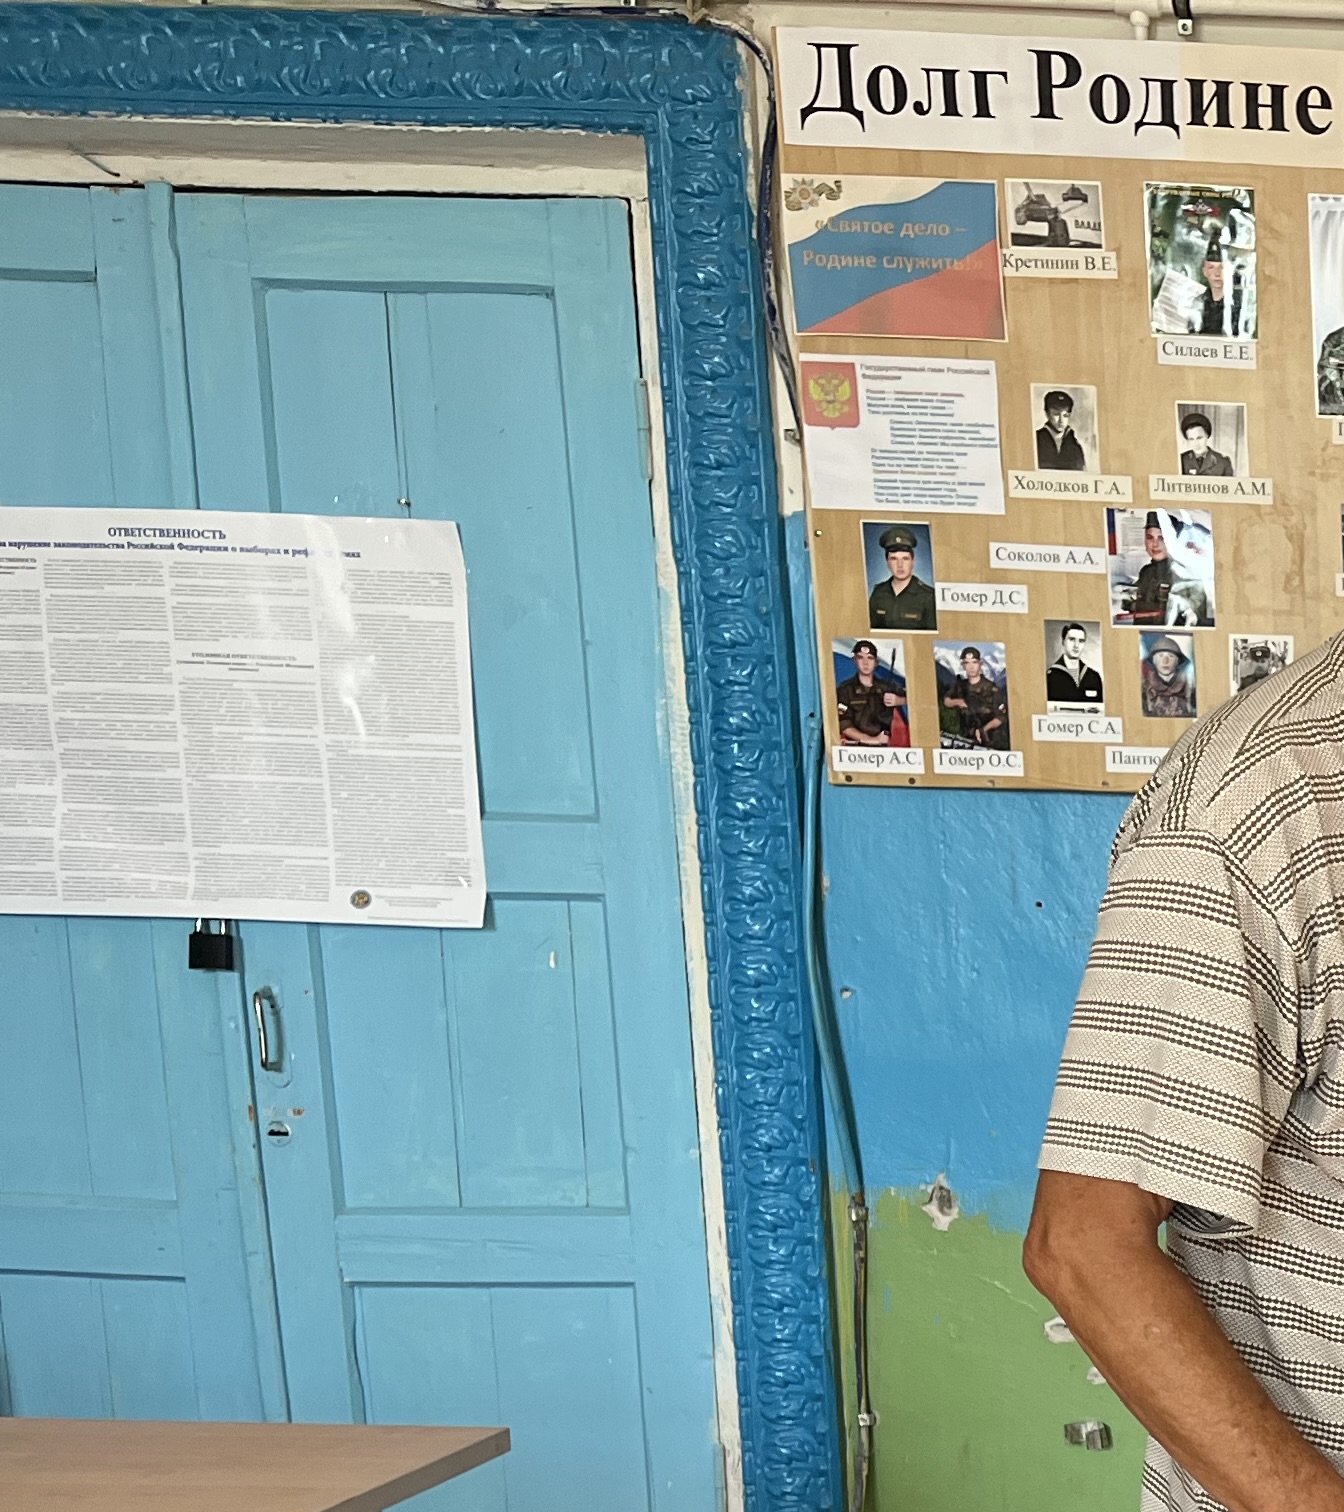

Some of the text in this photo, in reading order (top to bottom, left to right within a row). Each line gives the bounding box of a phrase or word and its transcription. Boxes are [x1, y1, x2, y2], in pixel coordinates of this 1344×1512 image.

[800, 42, 1008, 132] Долг
[1027, 48, 1333, 140] Родине
[815, 216, 895, 235] «Святое
[899, 222, 950, 238] дело
[803, 249, 877, 270] Родине
[1002, 253, 1117, 272] Кретинин В.Е.
[1162, 341, 1254, 361] Силаев Е.Е.
[1013, 473, 1126, 496] Холодков Г.А.
[1154, 478, 1271, 498] Литвинов А.М.
[107, 526, 227, 540] ОТВЕТСТВЕННОСТЬ
[996, 547, 1099, 566] Соколов А.А.
[941, 588, 1025, 608] Гомер Д.С.
[1037, 718, 1121, 738] Гомер С.А.
[837, 748, 921, 769] Гомер А.С.
[939, 752, 1022, 770] Гомер О.С.
